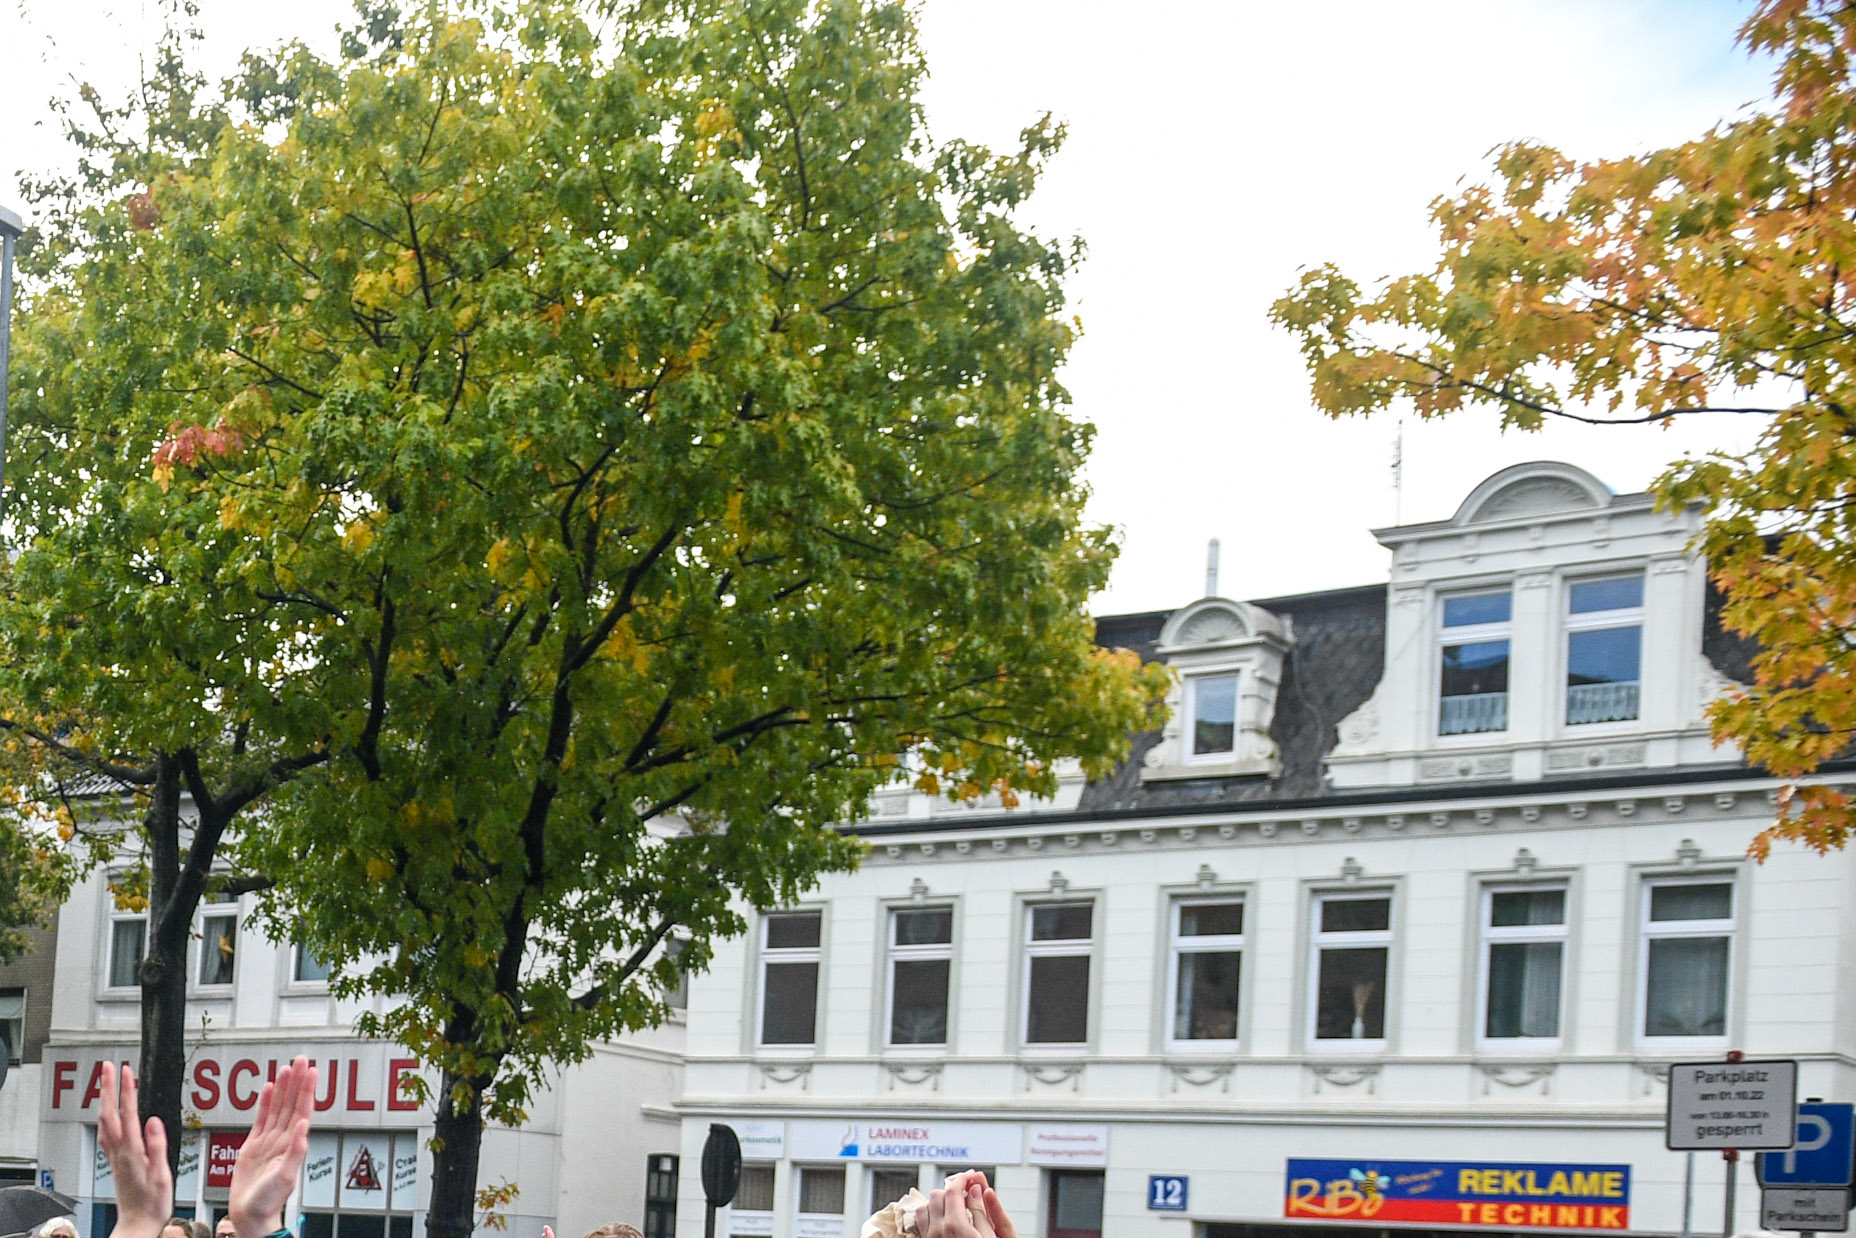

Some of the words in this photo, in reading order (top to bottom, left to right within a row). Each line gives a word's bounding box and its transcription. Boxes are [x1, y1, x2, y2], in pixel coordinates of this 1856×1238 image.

[1695, 1070, 1769, 1086] Parkplatz
[868, 1127, 930, 1139] LAMINEX
[1697, 1124, 1762, 1139] gesperrt
[867, 1144, 969, 1158] LABORTECHNIK
[1784, 1113, 1832, 1174] P
[1458, 1168, 1624, 1198] REKLAME
[1154, 1179, 1183, 1206] 12
[1456, 1202, 1622, 1228] TECHNIK
[1768, 1210, 1842, 1223] Parkschein
